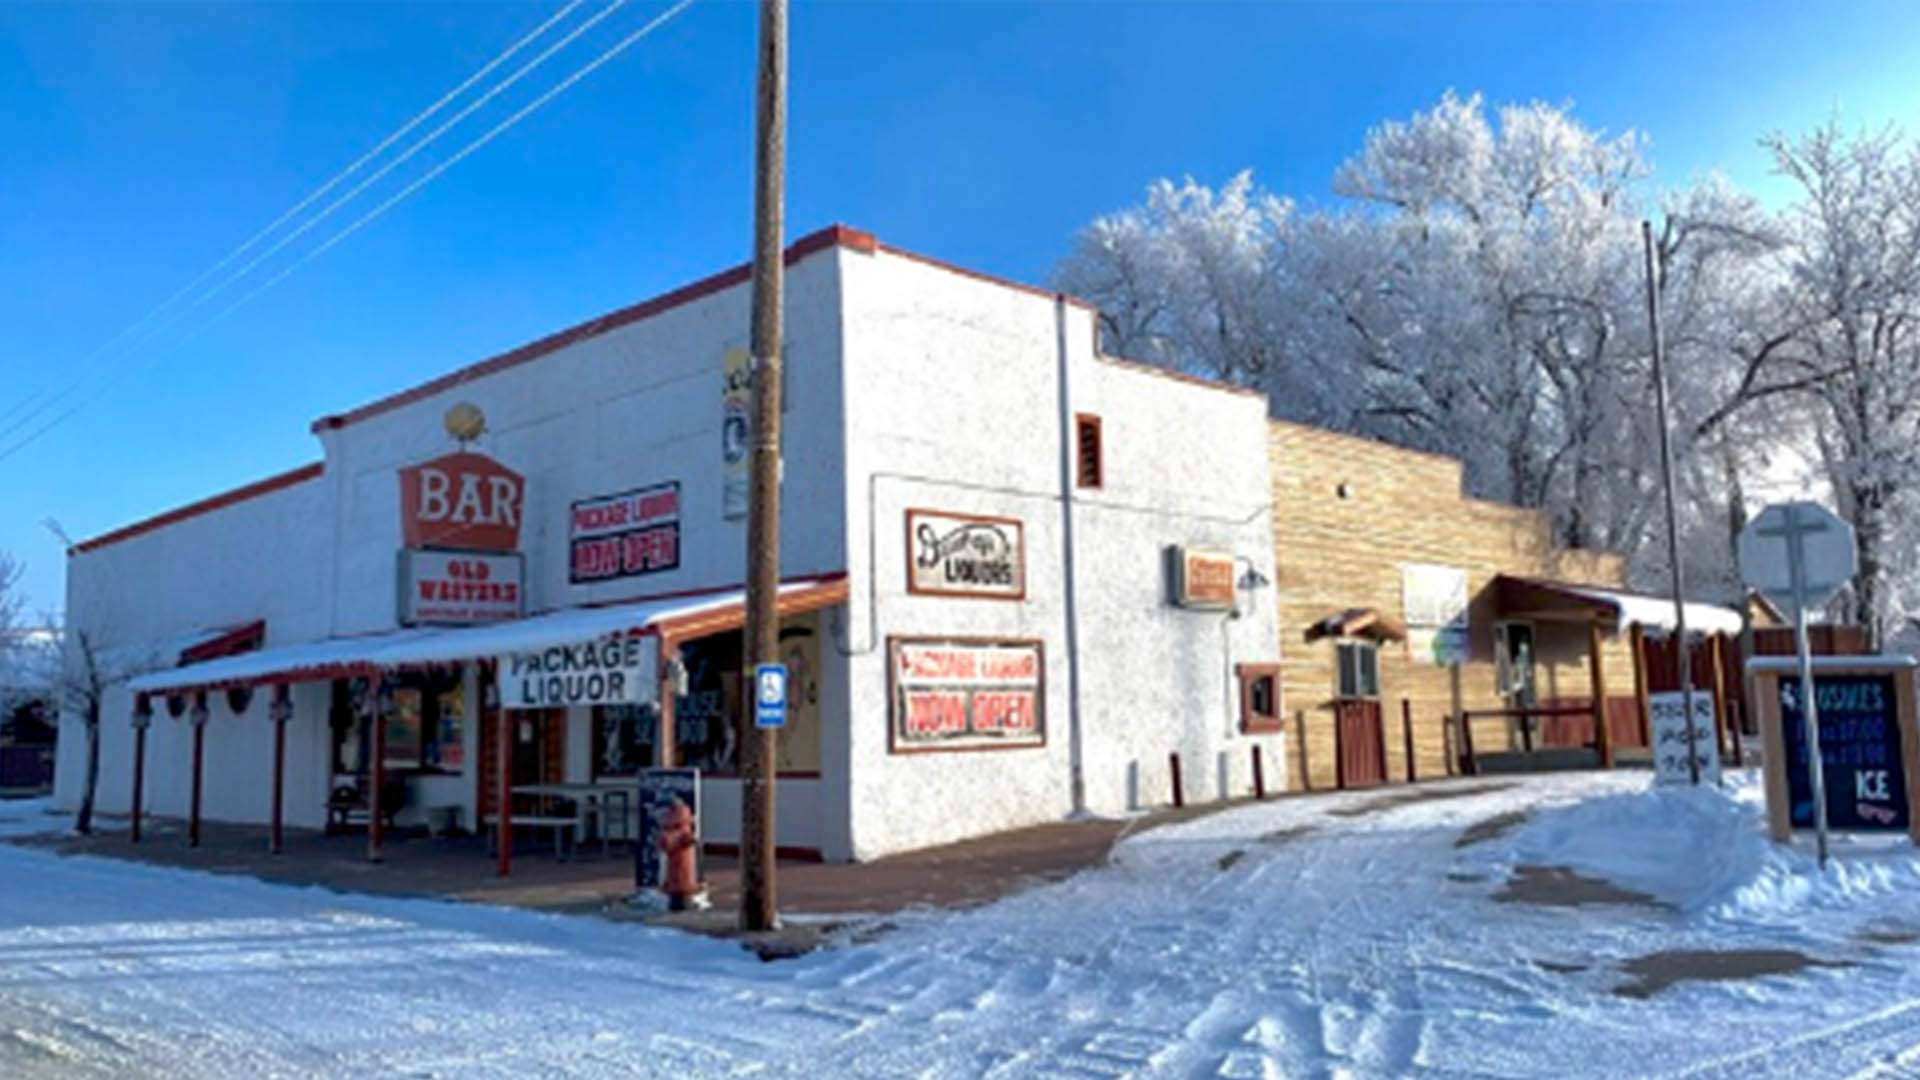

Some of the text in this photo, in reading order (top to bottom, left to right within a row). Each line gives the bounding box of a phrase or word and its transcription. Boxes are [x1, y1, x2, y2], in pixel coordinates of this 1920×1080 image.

[418, 469, 518, 528] BAR
[446, 560, 490, 579] OLD
[623, 529, 676, 573] OPEN
[521, 673, 626, 704] LIQUOR
[907, 691, 1035, 733] NOW OPEN
[1854, 769, 1891, 801] ICE
